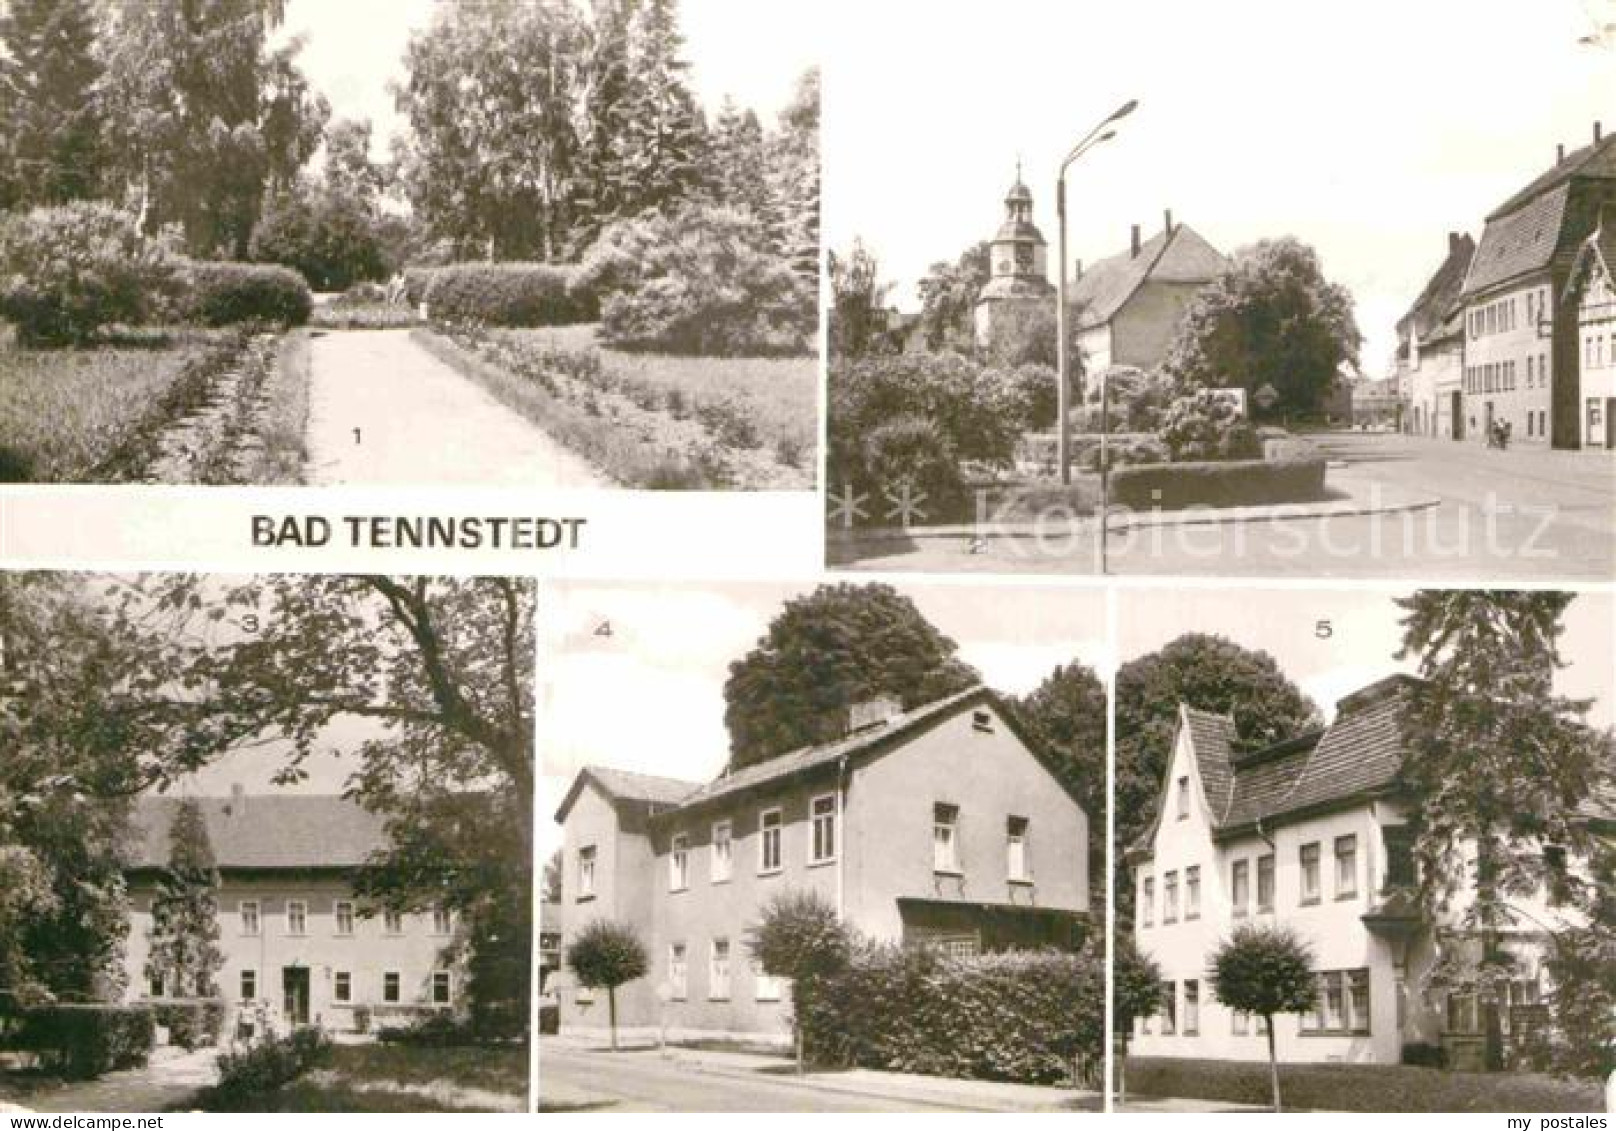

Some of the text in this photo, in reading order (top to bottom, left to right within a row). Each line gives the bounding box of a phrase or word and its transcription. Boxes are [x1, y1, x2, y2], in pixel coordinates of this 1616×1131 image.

[352, 427, 361, 444] 1
[251, 515, 588, 549] BAD TENNSTEDT
[241, 613, 259, 633] 3
[592, 618, 615, 638] 4
[1314, 619, 1333, 640] 5
